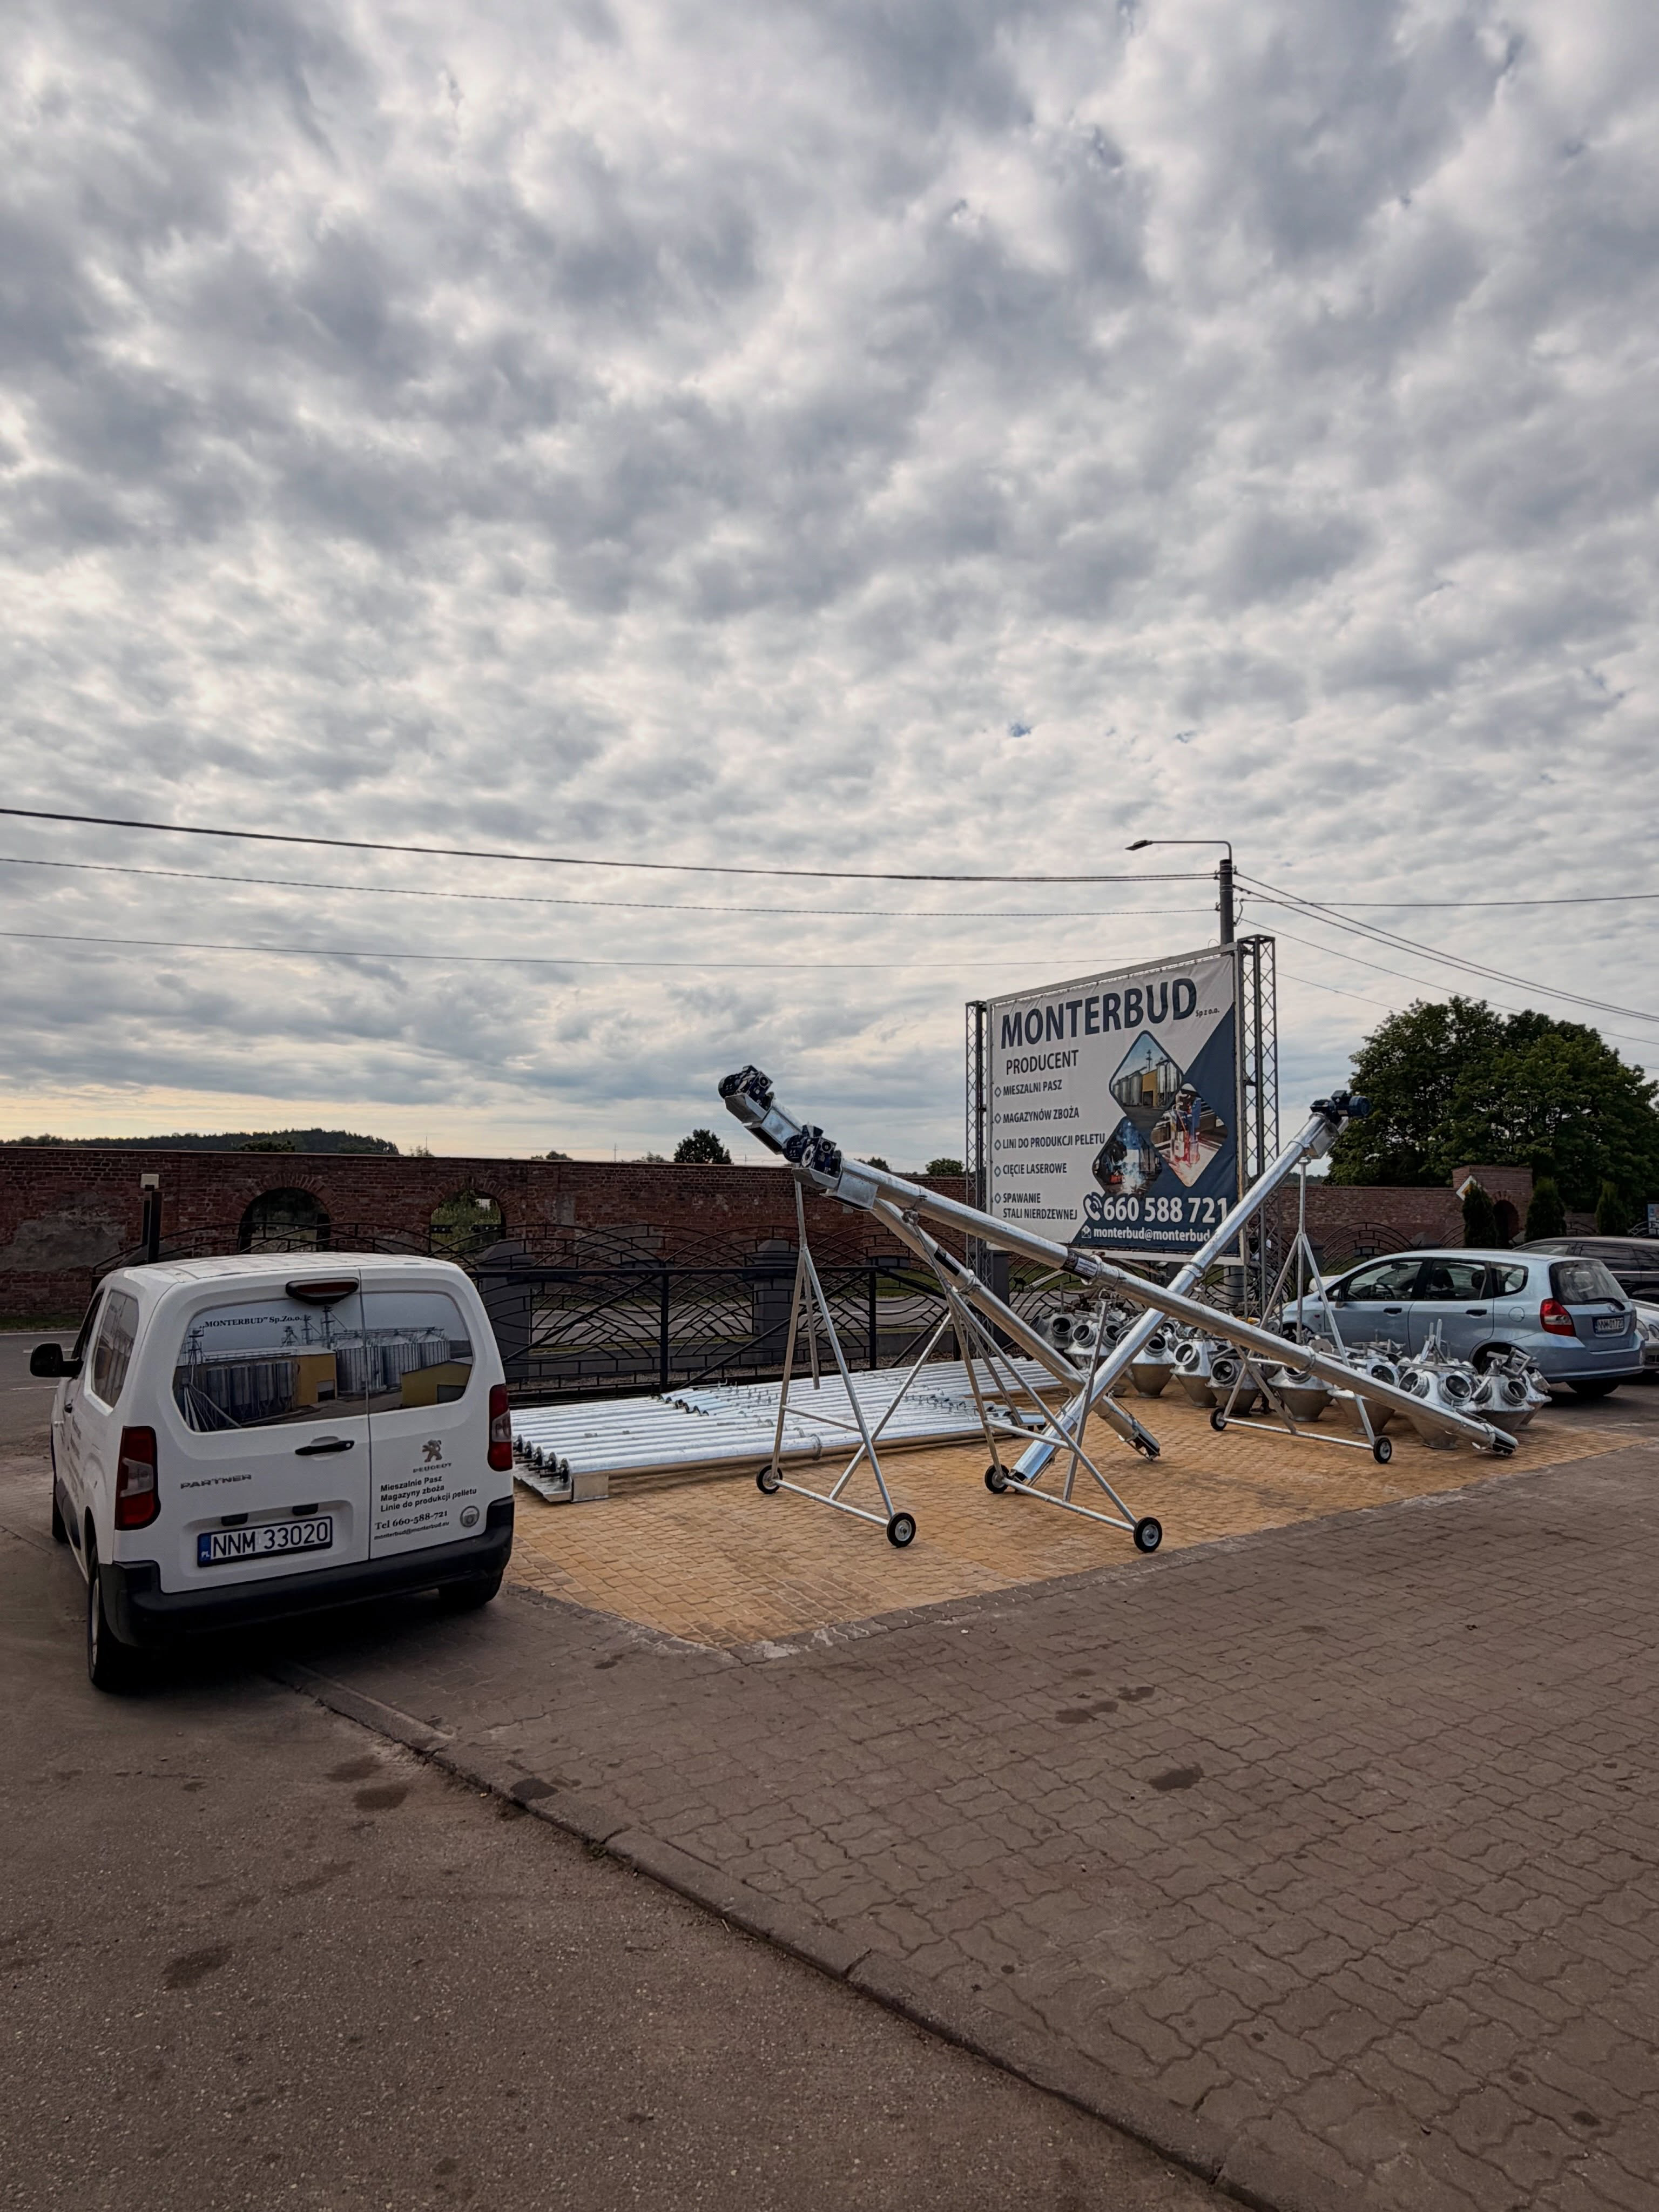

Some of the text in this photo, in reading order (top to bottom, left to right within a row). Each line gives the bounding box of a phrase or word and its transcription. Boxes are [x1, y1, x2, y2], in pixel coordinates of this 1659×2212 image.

[1001, 978, 1197, 1049] MONTERBUD
[1006, 1049, 1078, 1075] PRODUCENT
[1003, 1080, 1062, 1096] MIESZALNI PASZ
[1003, 1105, 1080, 1123] MAGAZYNÓW ZBOŻA
[1003, 1133, 1105, 1149] LINI DO PRODUKCJI PELETU
[1003, 1163, 1067, 1177] CIĘCIE LASEROWE
[1003, 1193, 1041, 1203] SPAWANIE
[1003, 1208, 1077, 1220] STALI NIERDZEWNEJ
[1103, 1197, 1227, 1224] 660 588 721
[1094, 1226, 1211, 1242] monterbud@monterbud
[413, 1462, 452, 1473] PEUGEOT
[180, 1474, 252, 1489] PARTNER
[381, 1476, 442, 1492] Mieszalnie Pasz
[381, 1485, 444, 1502] Magazyny zboża
[381, 1503, 400, 1512] Linie
[415, 1493, 450, 1507] produkcji
[453, 1488, 477, 1500] pelletu
[375, 1510, 448, 1530] Tel 660-588-721
[213, 1522, 328, 1557] NNM 33020
